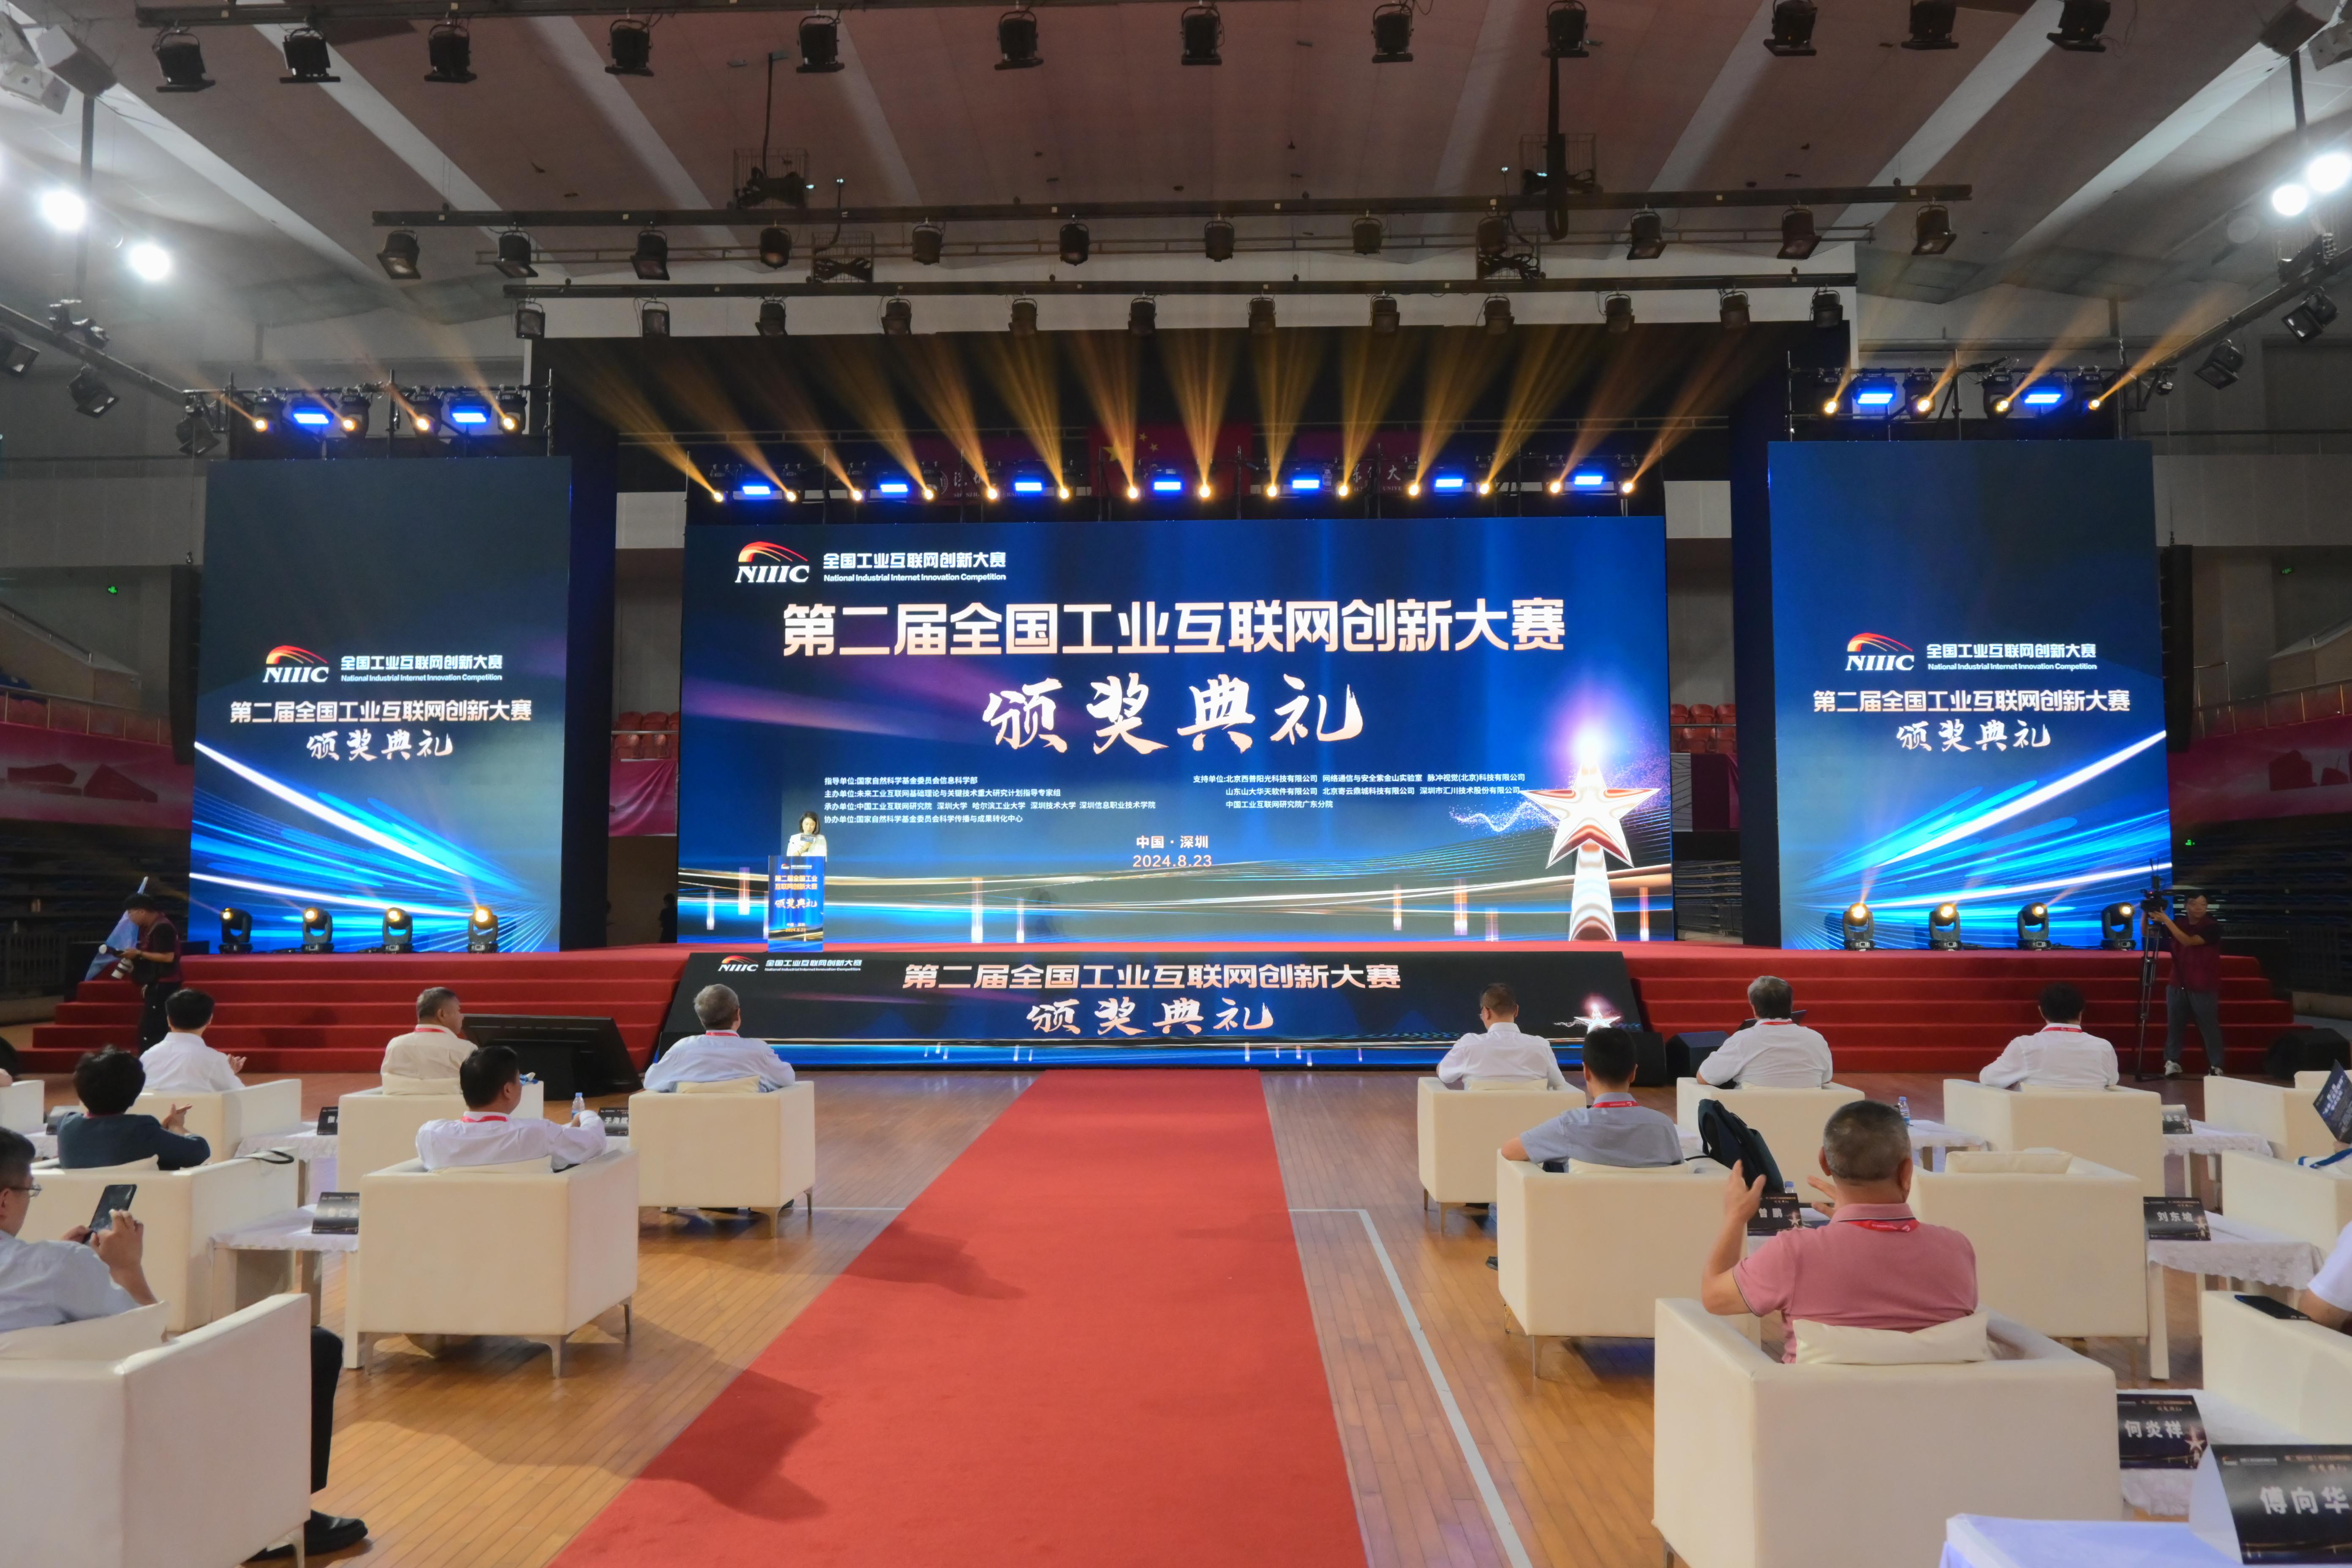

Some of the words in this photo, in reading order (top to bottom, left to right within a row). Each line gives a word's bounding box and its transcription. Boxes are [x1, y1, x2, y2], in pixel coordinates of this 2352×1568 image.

[823, 552, 1006, 568] 全国工业互联网创新大赛
[735, 565, 809, 583] NIIIC
[921, 573, 959, 581] Innovation
[961, 573, 1006, 583] Competition
[784, 598, 1565, 656] 第二届全国工业互联网创新大赛
[1927, 644, 2096, 659] 全国工业互联网创新大赛
[340, 655, 503, 670] 全国工业互联网创新大赛
[1845, 655, 1914, 671] NIIIC
[2055, 663, 2097, 672] Competition
[263, 667, 329, 683] NIIIC
[462, 674, 503, 682] Competition
[1813, 689, 2130, 712] 第二届全国工业互联网创新大赛
[230, 699, 532, 723] 第二届全国工业互联网创新大赛
[982, 672, 1364, 754] 颁奖典礼
[1896, 719, 2051, 752] 颁奖典礼
[306, 729, 453, 762] 颁奖典礼
[824, 776, 978, 785] 指导单位:国家自然科学基金委员会信息科学部
[1193, 774, 1318, 783] 支持单位:北京西普阳光科技有限公司
[1323, 774, 1422, 783] 网络通信与安全紫金山实验室
[1427, 773, 1525, 782] 脉冲视觉(北京)科技有限公司
[824, 789, 1061, 798] 主办单位:未来工业互联网基础理论与关键技术重大研究计划指导专家组
[1226, 787, 1318, 796] 山东山大华天软件有限公司
[1323, 787, 1415, 795] 北京寄云鼎城科技有限公司
[1420, 786, 1520, 795] 深圳市汇川技术股份有限公司
[824, 803, 932, 811] 承办单位:中国工业互联网研究院
[937, 802, 968, 810] 深圳大学
[972, 802, 1026, 810] 哈尔滨工业大学
[1030, 801, 1076, 809] 深圳技术大学
[1079, 801, 1156, 809] 深圳信息职业技术学院
[1226, 800, 1334, 808] 中国工业互联网研究院广东分院
[824, 814, 1023, 824] 协办单位:国家自然科学基金委员会科学传播与成果转化中心
[1132, 855, 1213, 867] 2024.8.23
[902, 964, 1401, 989] 第二届全国工业互联网创新大赛
[1026, 996, 1274, 1035] 颁奖典礼
[2124, 1420, 2183, 1438] 何炎祥
[2260, 1486, 2350, 1515] 傅向华
